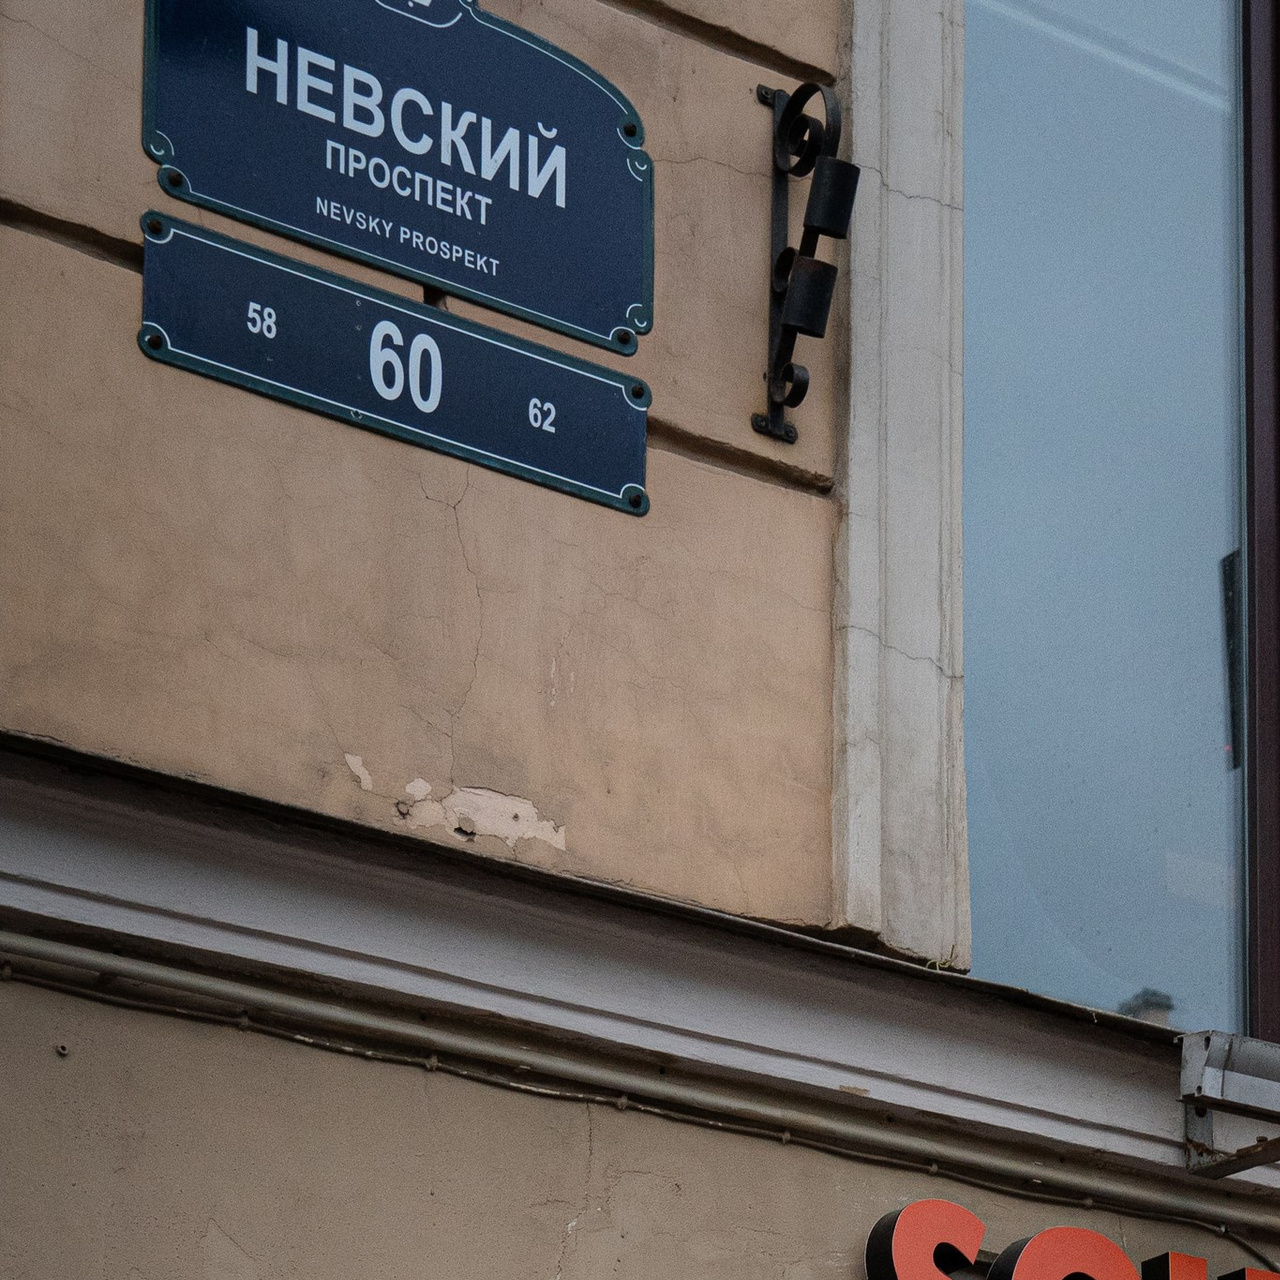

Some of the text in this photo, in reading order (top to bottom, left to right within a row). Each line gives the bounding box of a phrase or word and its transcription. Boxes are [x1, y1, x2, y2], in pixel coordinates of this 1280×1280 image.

[245, 26, 568, 208] НЕВСКИЙ
[315, 196, 500, 277] NEVSKY PROSPEKT
[326, 139, 492, 226] ПРОСПЕКТ
[246, 302, 557, 434] 58 60 62
